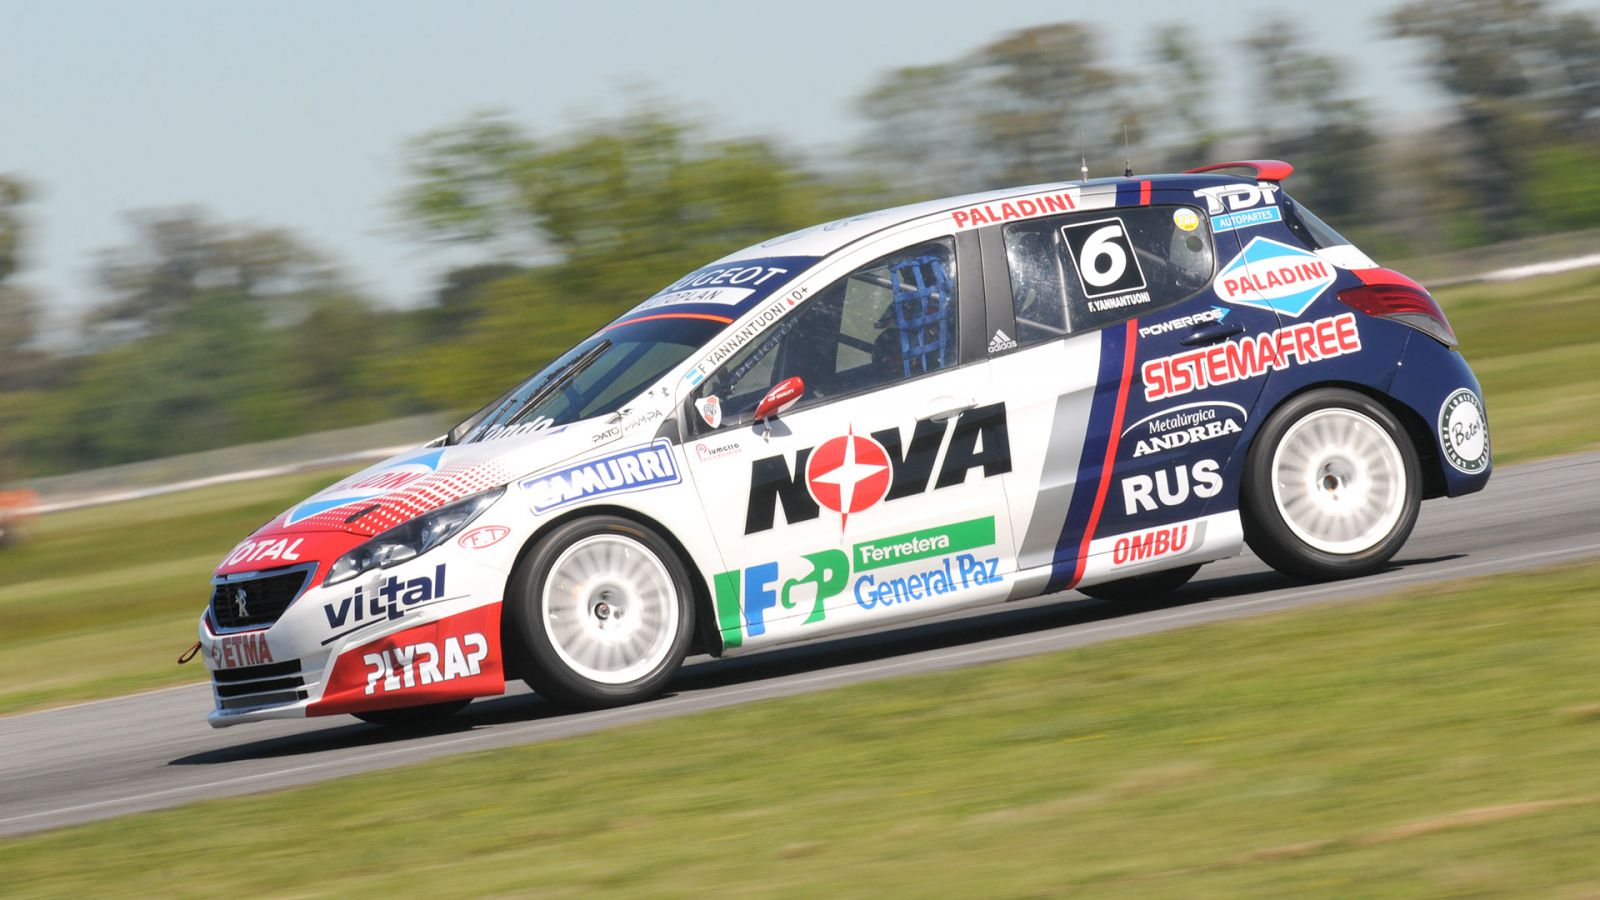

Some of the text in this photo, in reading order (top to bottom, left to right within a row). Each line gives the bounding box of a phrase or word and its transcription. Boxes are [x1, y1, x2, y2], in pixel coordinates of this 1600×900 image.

[951, 193, 1077, 228] PALADINI
[1193, 182, 1279, 215] TDI
[1219, 210, 1273, 228] AUTOPARTES
[1079, 225, 1127, 288] 6
[672, 266, 788, 292] UGEOT
[1223, 260, 1329, 298] PALADINI
[699, 302, 786, 375] F YANNANTUONI
[1138, 309, 1224, 338] POWERADE
[988, 339, 1018, 353] adidas
[1143, 314, 1360, 400] SISTEMAFREE
[592, 427, 620, 443] PATO
[1133, 418, 1242, 458] ANDREA
[1149, 409, 1216, 434] Metalúrgica
[744, 401, 1012, 535] NOVA
[1121, 459, 1223, 516] RUS
[218, 537, 304, 570] TOTAL
[859, 532, 950, 564] Ferretera
[1113, 524, 1188, 565] OMBU
[324, 563, 446, 630] vittal
[854, 552, 1004, 610] General Paz
[222, 631, 274, 669] ETMA
[363, 632, 488, 696] PLYRAP
